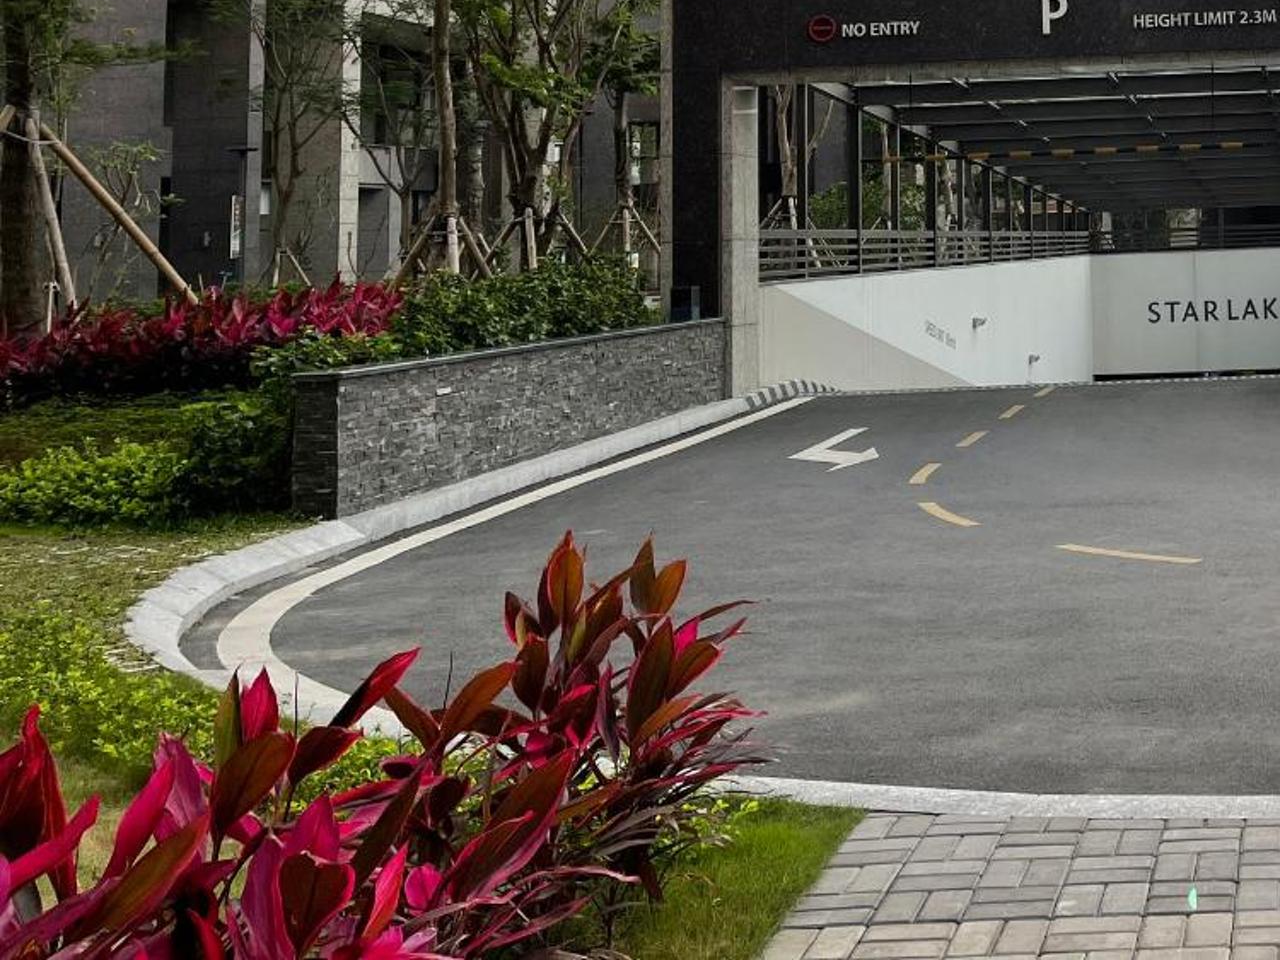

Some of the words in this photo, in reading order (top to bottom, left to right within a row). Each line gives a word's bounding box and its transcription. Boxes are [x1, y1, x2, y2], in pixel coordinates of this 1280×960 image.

[1133, 12, 1192, 29] HEIGHT
[1194, 10, 1236, 26] LIMIT
[1239, 9, 1277, 25] 2.3M
[841, 22, 867, 38] NO
[870, 20, 921, 36] ENTRY
